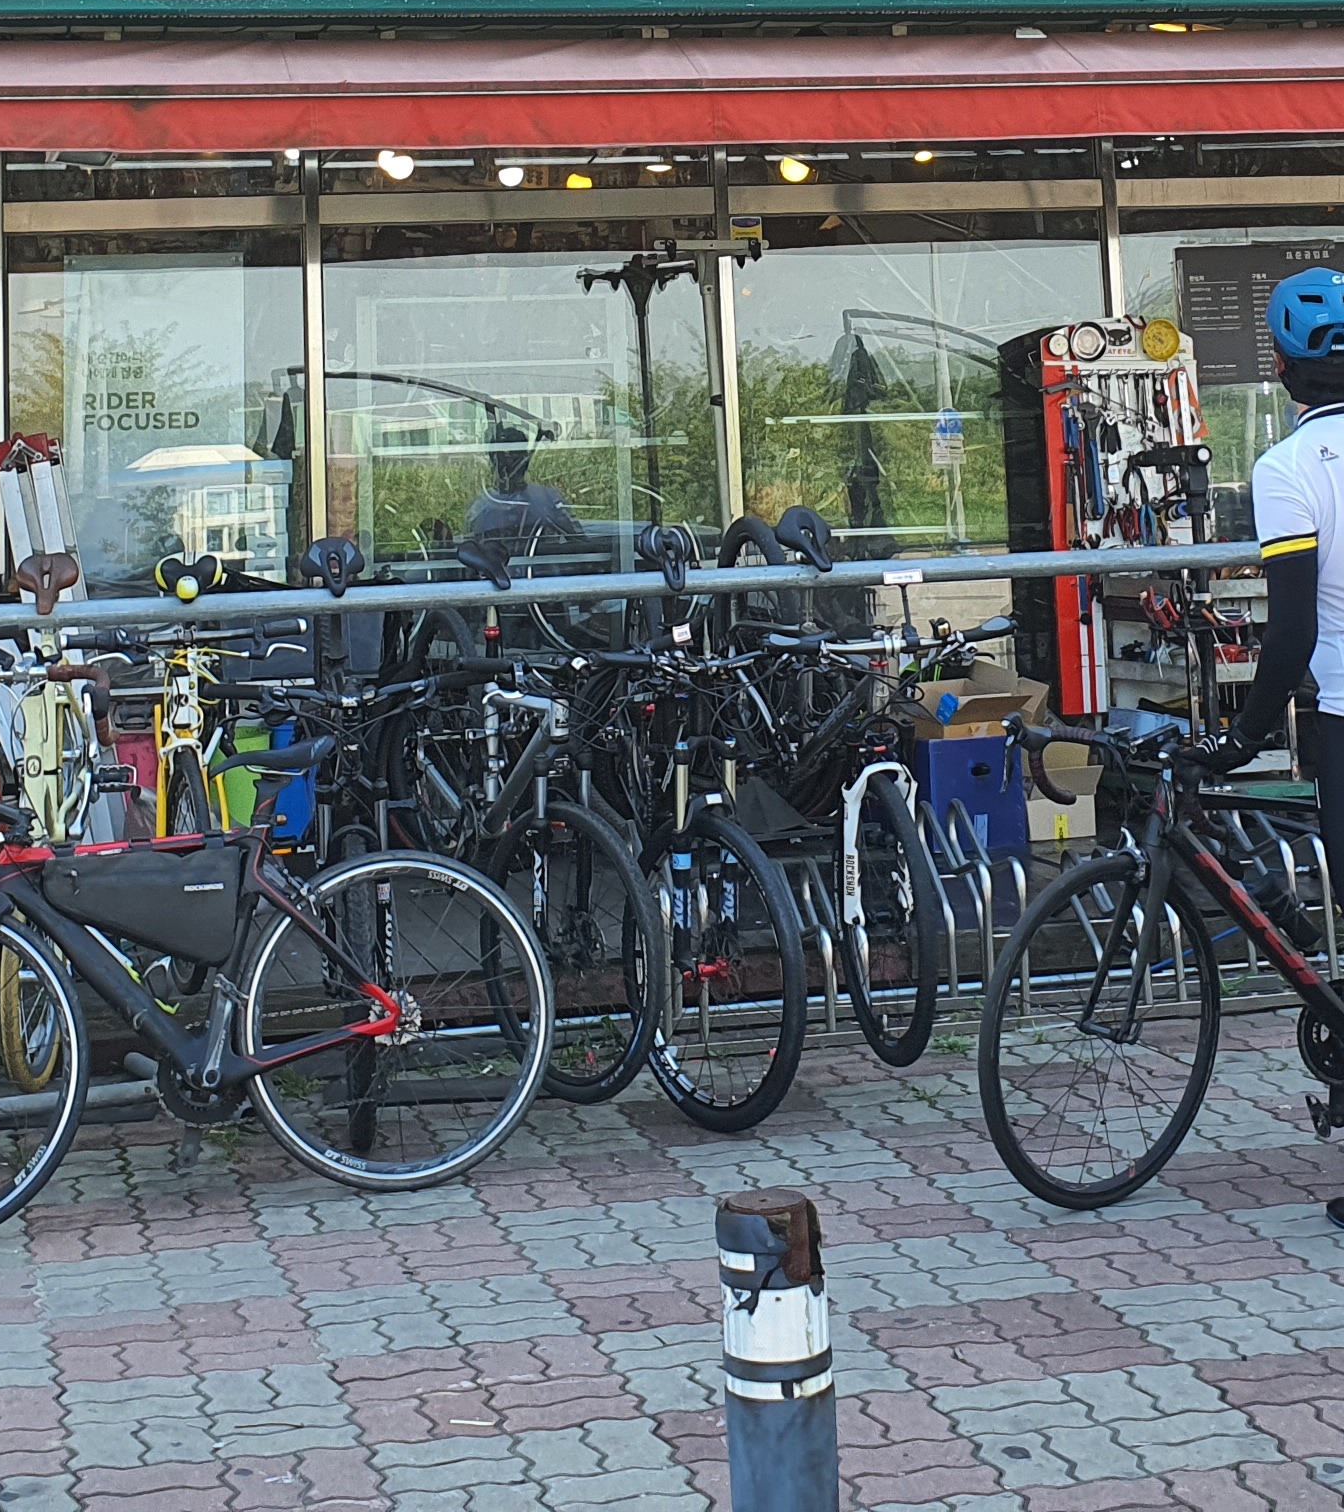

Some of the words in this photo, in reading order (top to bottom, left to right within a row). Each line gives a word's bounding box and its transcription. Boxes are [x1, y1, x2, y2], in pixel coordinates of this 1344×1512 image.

[82, 391, 156, 411] RIDER
[83, 411, 200, 432] FOCUSED
[427, 870, 456, 884] SWISS
[453, 875, 469, 892] DT
[845, 854, 855, 897] ROCKSHOX
[13, 1168, 27, 1186] DT
[26, 1144, 47, 1172] SWISS
[324, 1149, 341, 1160] DT
[340, 1155, 367, 1170] SWISS
